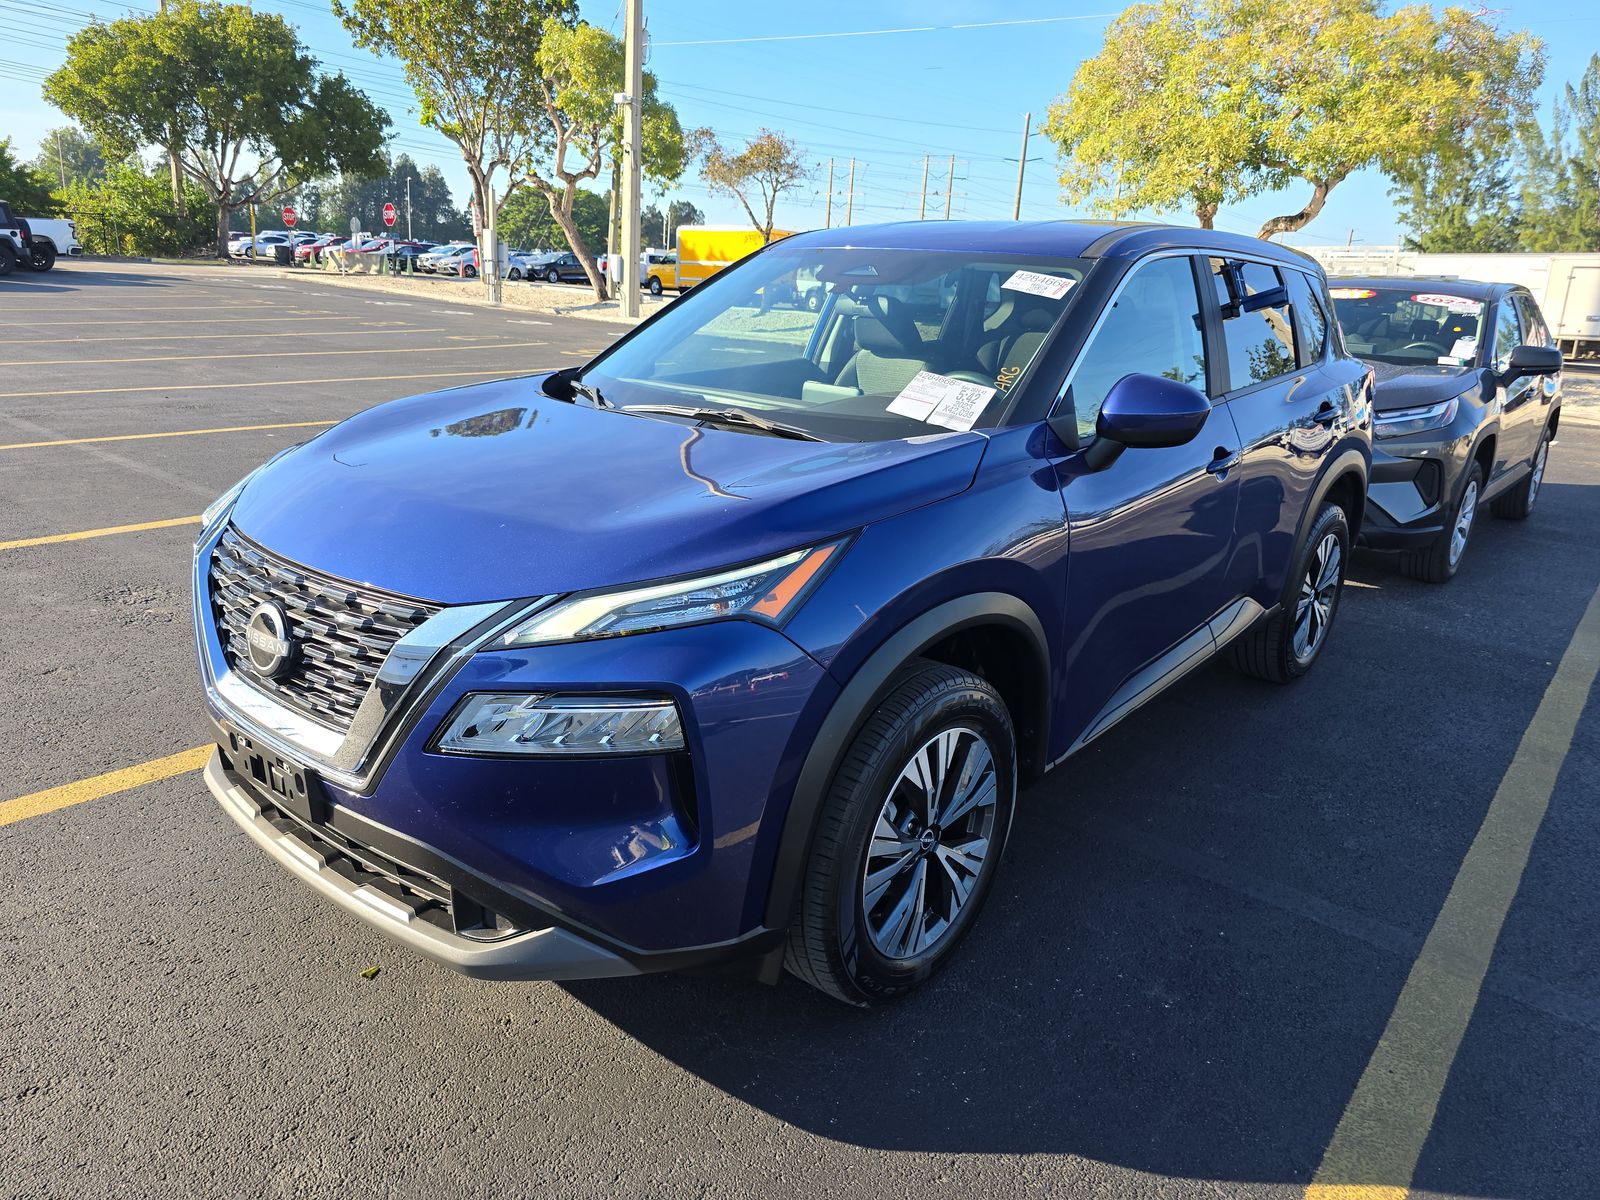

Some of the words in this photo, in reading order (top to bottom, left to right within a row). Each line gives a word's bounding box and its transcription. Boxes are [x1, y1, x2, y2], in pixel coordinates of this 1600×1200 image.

[283, 212, 295, 220] STOP
[383, 209, 396, 220] STOP
[918, 371, 957, 386] 4284668
[955, 390, 981, 405] 5:42
[942, 404, 975, 419] X42,039
[952, 401, 973, 411] 2023
[246, 626, 287, 654] NISSAN
